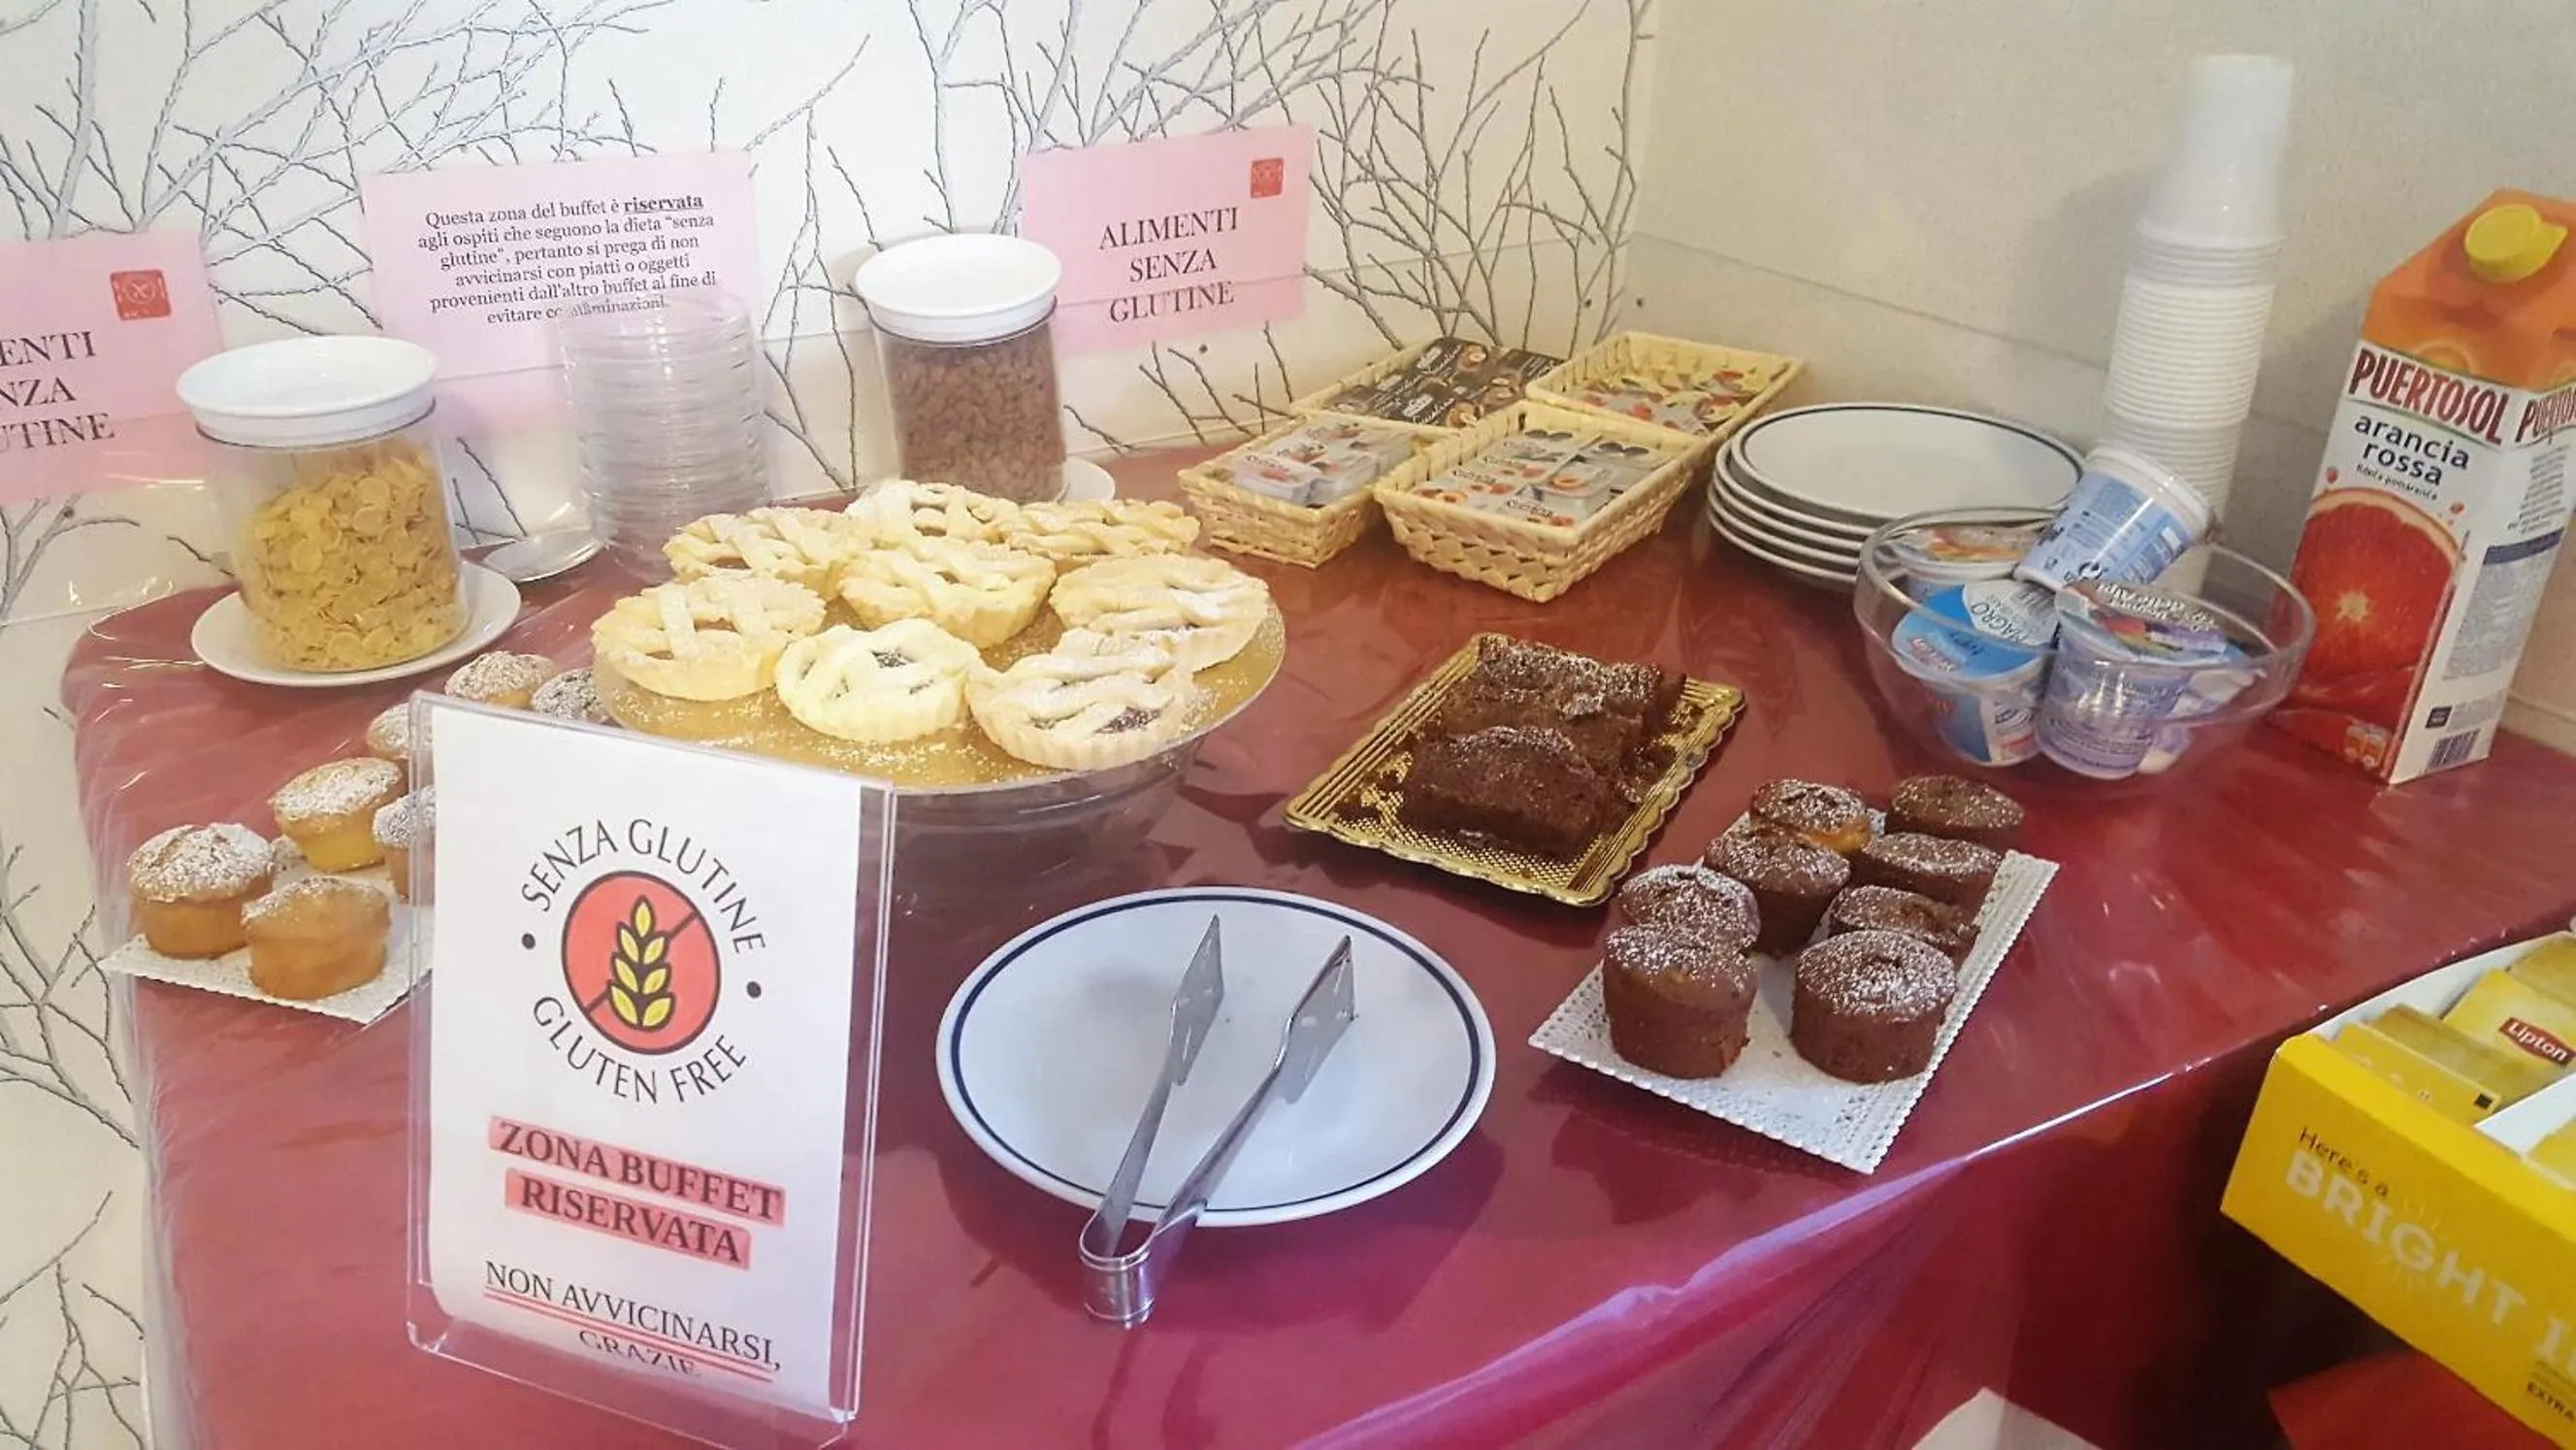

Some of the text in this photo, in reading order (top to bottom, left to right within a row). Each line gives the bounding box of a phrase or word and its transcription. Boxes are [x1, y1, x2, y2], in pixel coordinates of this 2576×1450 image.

[418, 232, 448, 251] agli
[452, 228, 499, 247] ospiti
[504, 225, 532, 242] che
[535, 223, 602, 242] seguono
[605, 219, 620, 235] la
[624, 216, 662, 233] dieta
[426, 195, 703, 229] Questa zona del buffet è riservata
[1099, 207, 1239, 249] ALIMENTI
[455, 253, 690, 287] avvicinarsi con piatti o oggetti
[515, 243, 583, 265] pertanto
[586, 241, 601, 255] si
[604, 241, 647, 258] prega
[651, 235, 667, 250] di
[670, 236, 701, 249] non
[1129, 247, 1218, 282] SENZA
[430, 286, 525, 313] provenienti
[602, 277, 648, 294] buffet
[652, 275, 667, 290] al
[670, 274, 699, 289] fine
[702, 271, 716, 286] di
[1109, 280, 1235, 323] GLUTINE
[487, 308, 542, 324] evitare
[2348, 347, 2510, 446] PUERTOSOL
[2354, 413, 2470, 472] arancia
[2362, 440, 2444, 486] rossa
[521, 817, 766, 954] SENZA GLUTINE
[533, 996, 747, 1104] GLUTEN FREE
[2506, 1019, 2569, 1063] Lipton
[499, 1121, 783, 1221] ZONA BUFFET
[2297, 1126, 2391, 1198] Here's a
[520, 1175, 741, 1264] RISERVATA
[2284, 1149, 2528, 1327] BRIGHT
[485, 1261, 781, 1373] NON AVVICINARSI,
